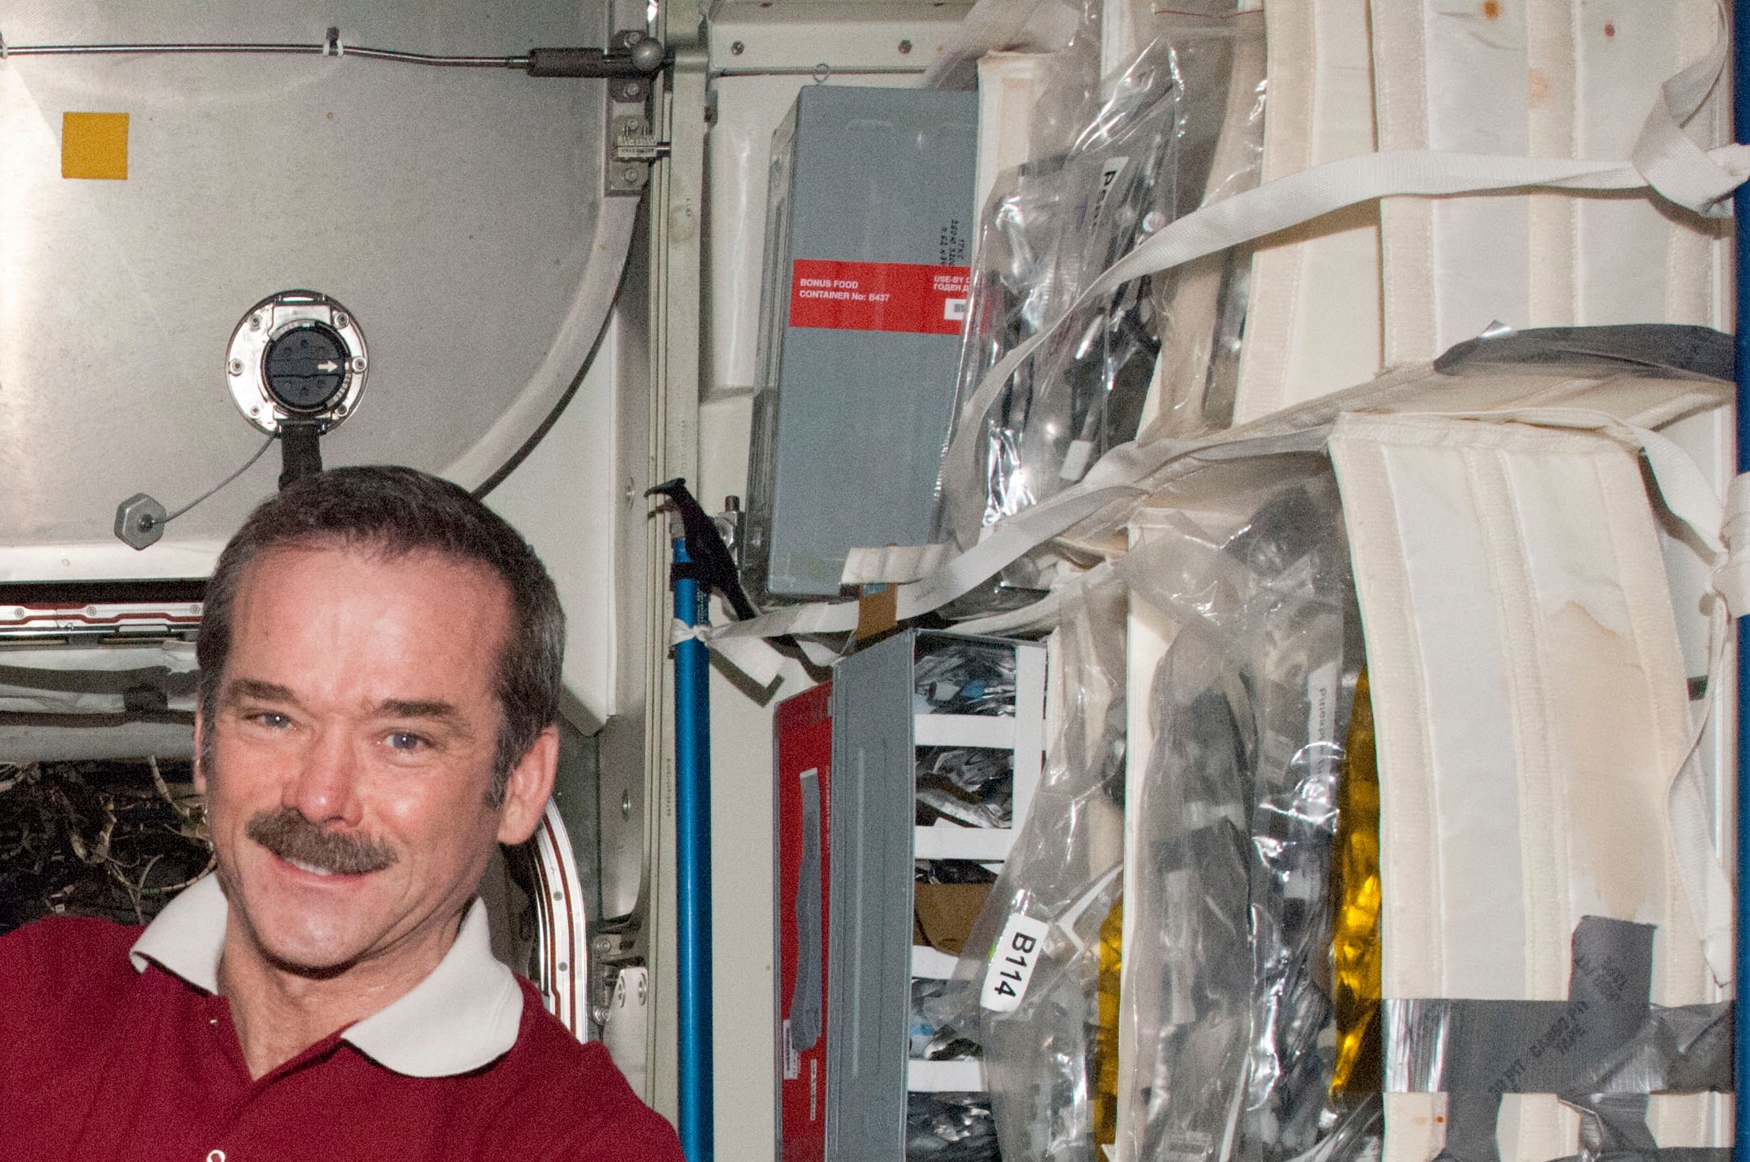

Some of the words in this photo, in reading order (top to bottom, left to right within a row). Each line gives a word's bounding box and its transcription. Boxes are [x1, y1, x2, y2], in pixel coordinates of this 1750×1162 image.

[801, 279, 831, 288] BONUS
[834, 281, 858, 289] FOOD
[934, 276, 964, 284] USE-BY
[800, 290, 849, 300] CONTAINER
[994, 932, 1037, 997] B114
